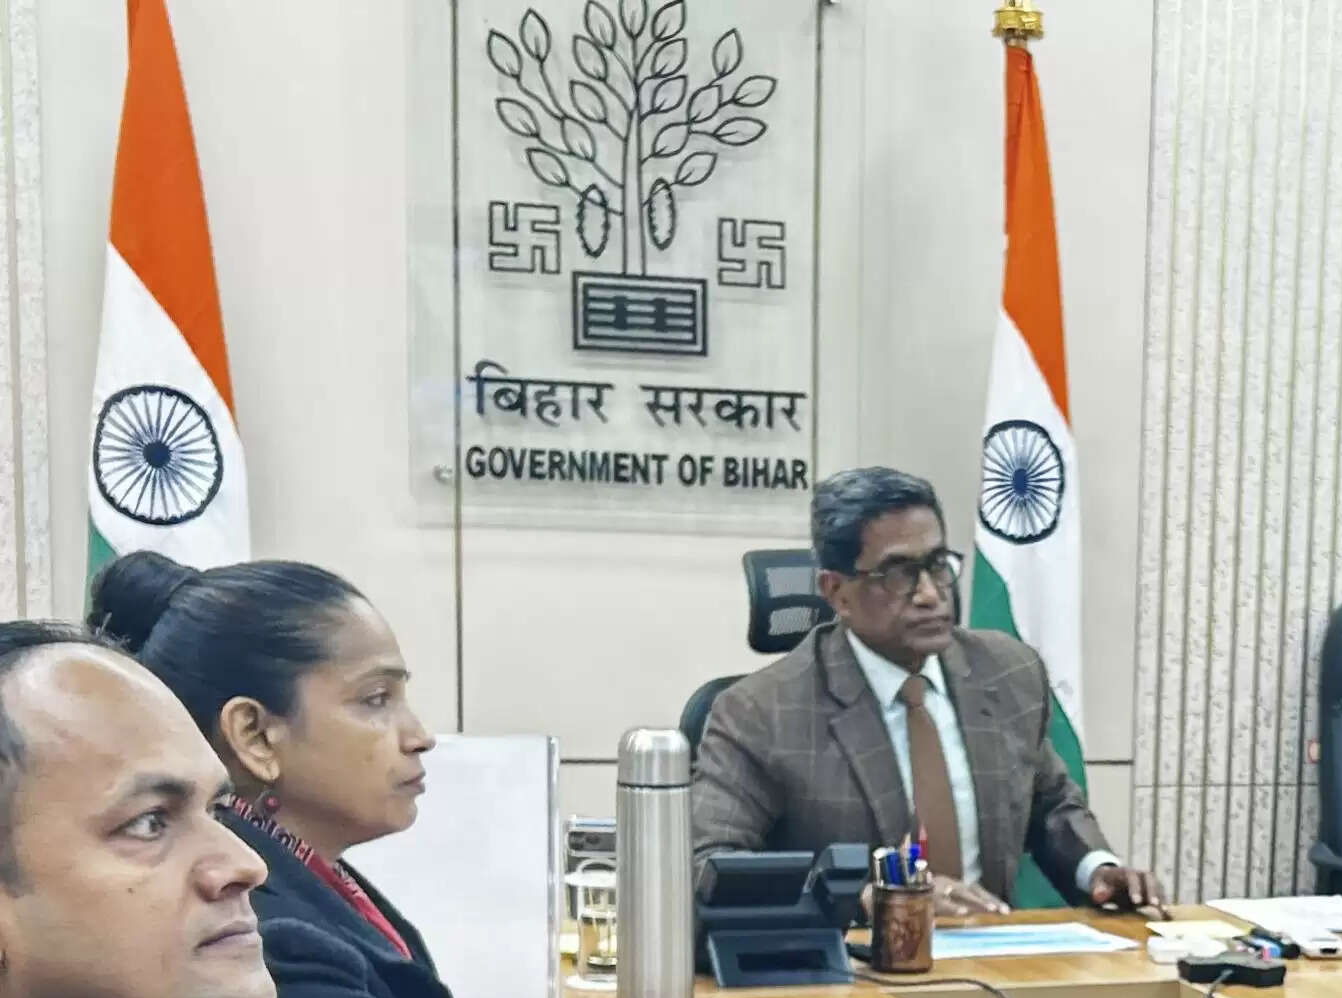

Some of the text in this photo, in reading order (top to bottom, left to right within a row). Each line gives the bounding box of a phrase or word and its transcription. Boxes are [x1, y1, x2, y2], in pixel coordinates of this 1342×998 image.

[466, 360, 808, 431] बिहार सरकार
[465, 445, 808, 490] GOVERNMENT OF BIHAR
